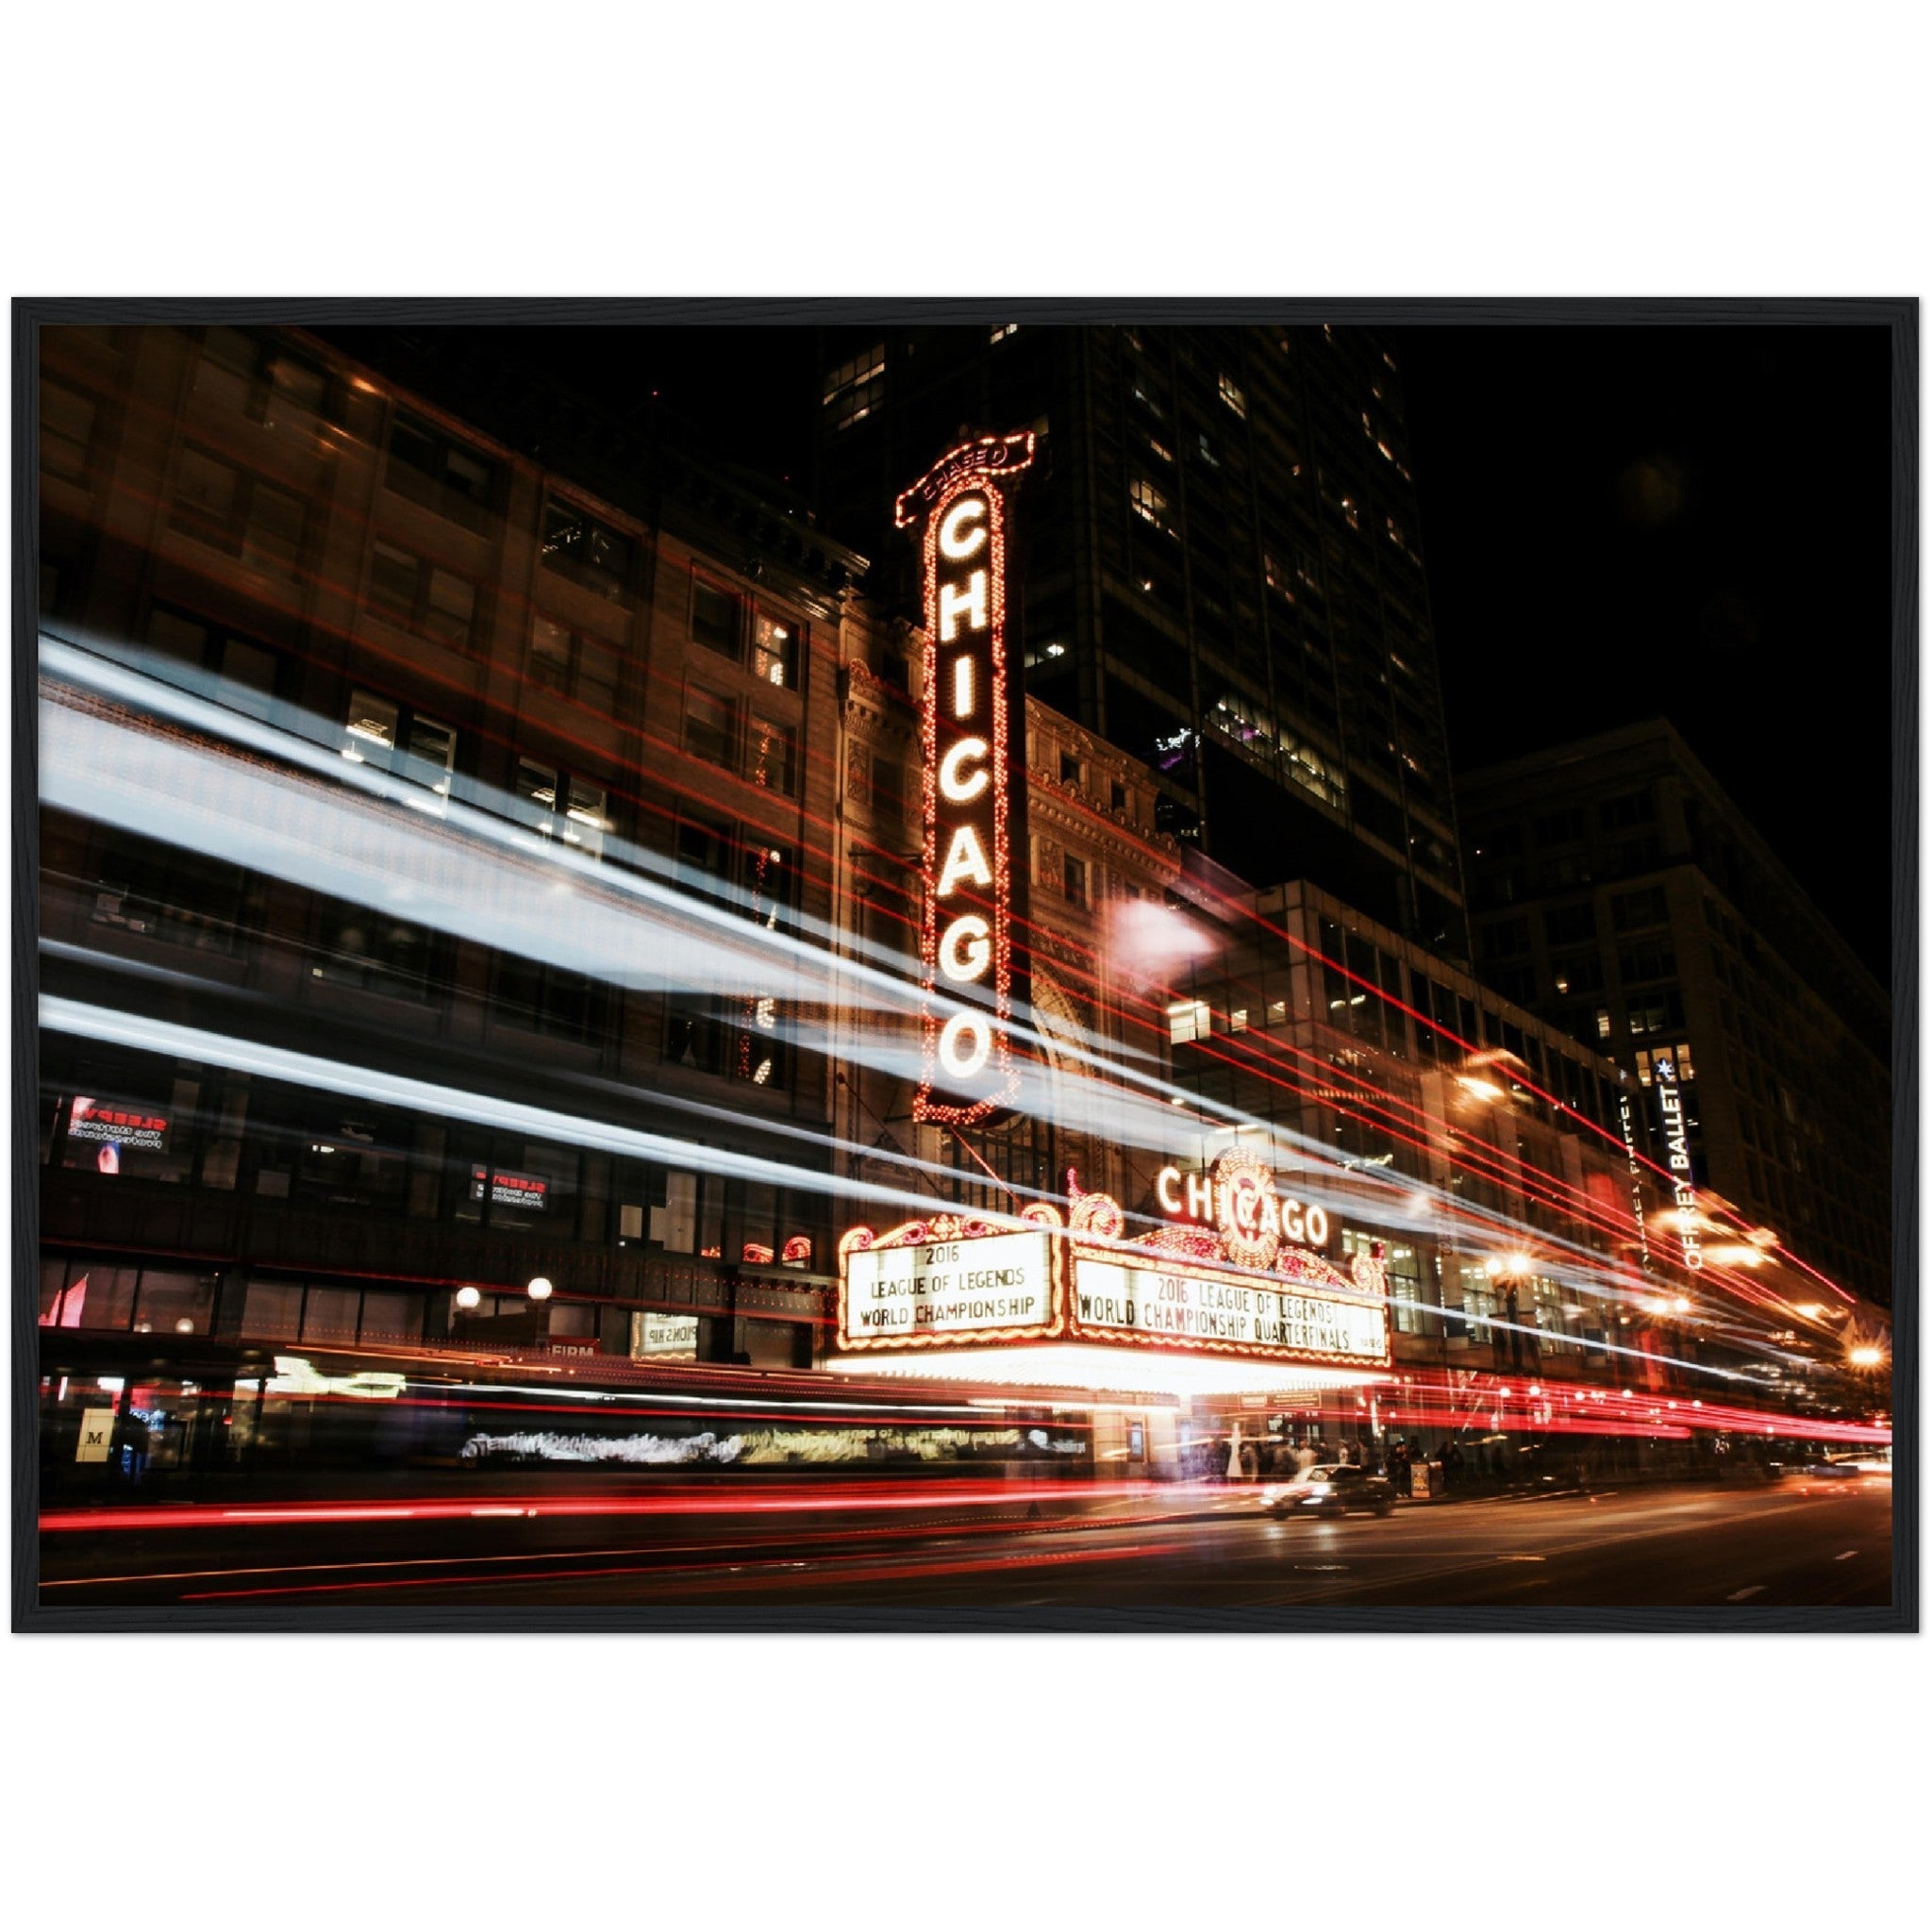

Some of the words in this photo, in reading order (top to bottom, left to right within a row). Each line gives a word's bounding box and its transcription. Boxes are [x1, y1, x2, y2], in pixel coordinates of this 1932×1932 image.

[940, 499, 992, 1078] CHICAGO
[1659, 1085, 1690, 1170] BALLET
[1158, 1166, 1328, 1245] CHICAGO
[925, 1245, 959, 1265] 2016
[871, 1276, 926, 1299] LEAGUE
[932, 1275, 950, 1292] OF
[958, 1267, 1024, 1291] LEGENDS
[1158, 1277, 1189, 1304] 2016
[1199, 1284, 1250, 1312] LEAGUE
[1257, 1293, 1273, 1314] OF
[1279, 1296, 1331, 1324] LEGENDS
[860, 1307, 908, 1326] WORLD
[915, 1296, 1035, 1324] CHAMPIONSHIP
[1079, 1293, 1135, 1326] WORLD
[1144, 1303, 1246, 1338] CHAMPIONSHIP
[1255, 1318, 1350, 1350] QUARTERFINALS
[86, 1432, 103, 1444] M
